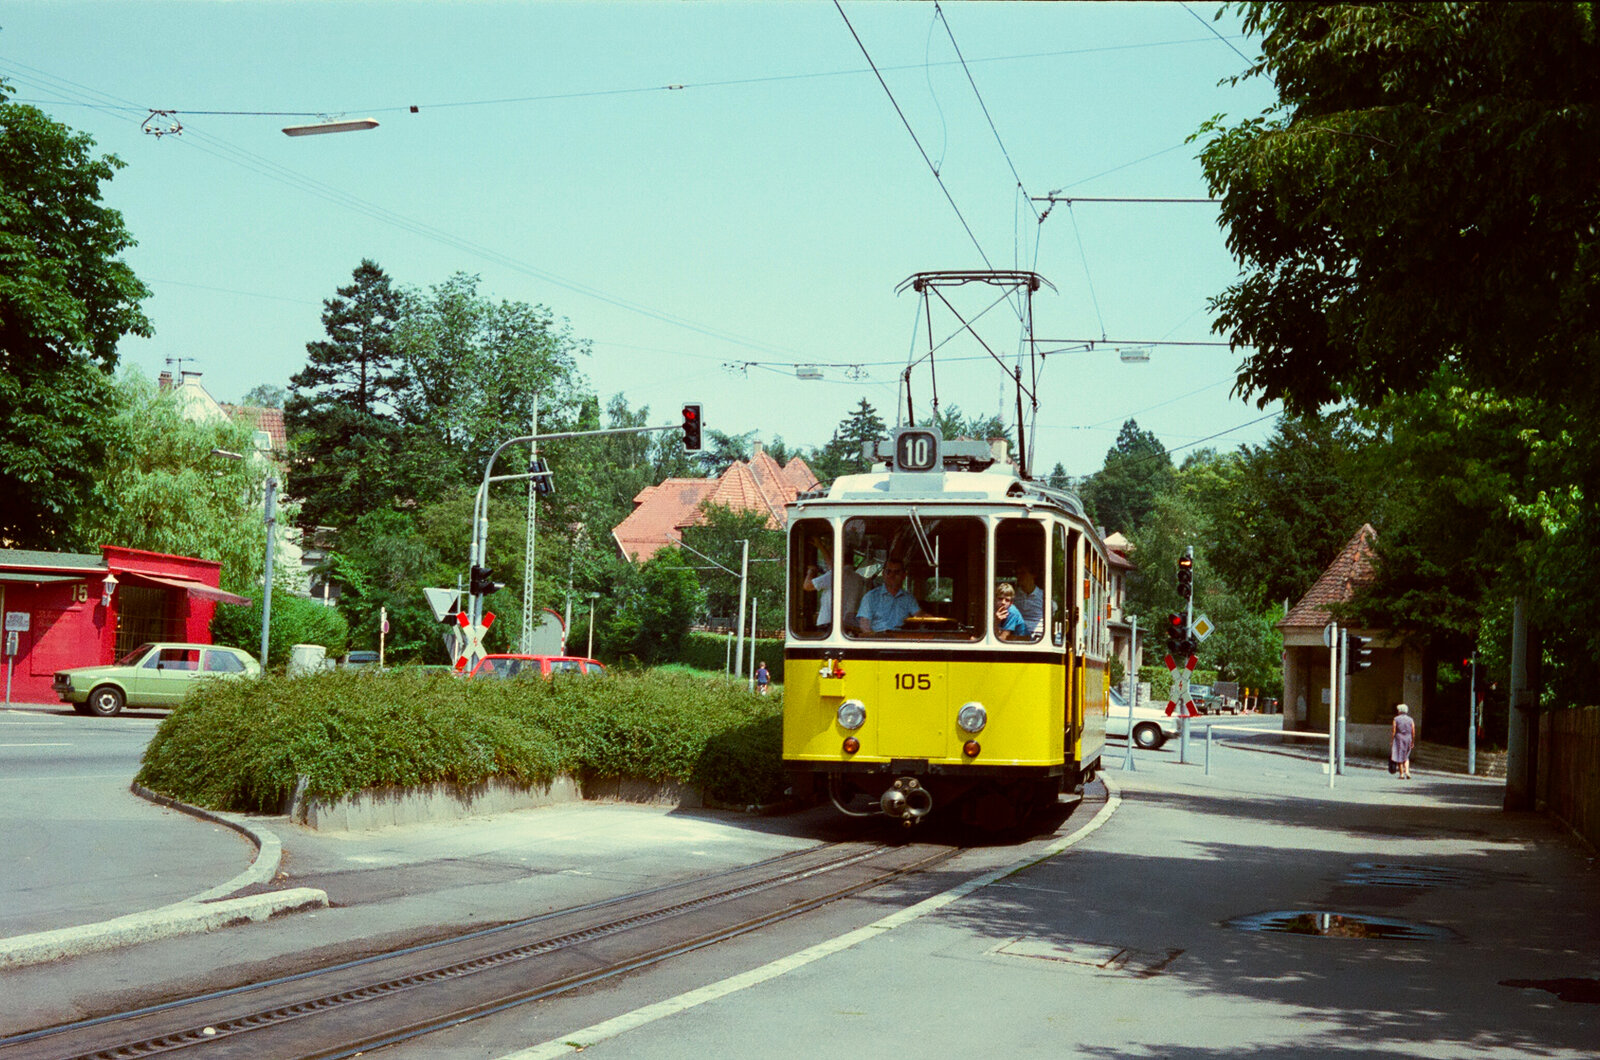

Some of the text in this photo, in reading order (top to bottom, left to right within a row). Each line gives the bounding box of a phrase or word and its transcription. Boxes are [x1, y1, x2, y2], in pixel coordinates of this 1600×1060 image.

[905, 438, 928, 466] 10
[71, 584, 88, 603] 15
[894, 673, 931, 691] 105
